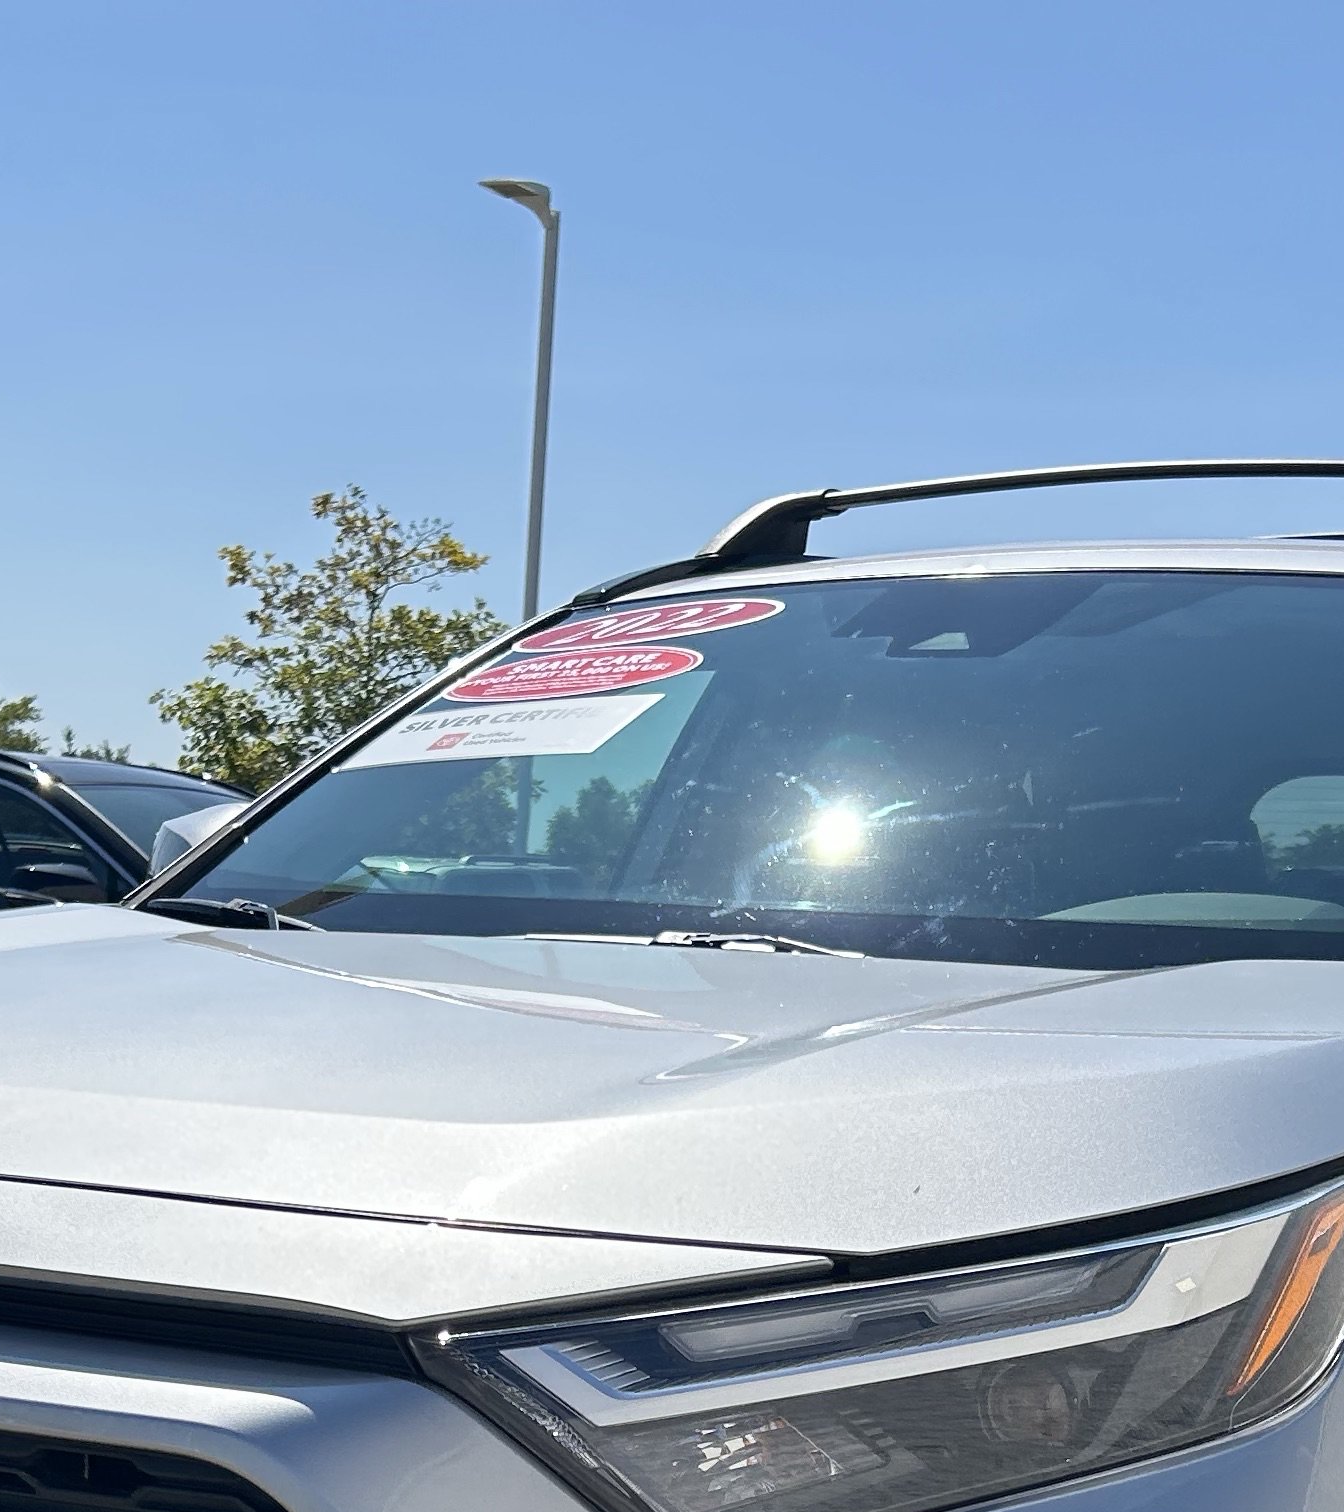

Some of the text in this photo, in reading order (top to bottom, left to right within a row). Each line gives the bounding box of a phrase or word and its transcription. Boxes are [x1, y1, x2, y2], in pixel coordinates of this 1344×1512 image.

[541, 602, 746, 647] 2022
[507, 652, 663, 675] SMART CARE
[515, 669, 561, 681] FIRST
[612, 663, 641, 674] ON
[398, 706, 608, 734] SILVER CERTIFI
